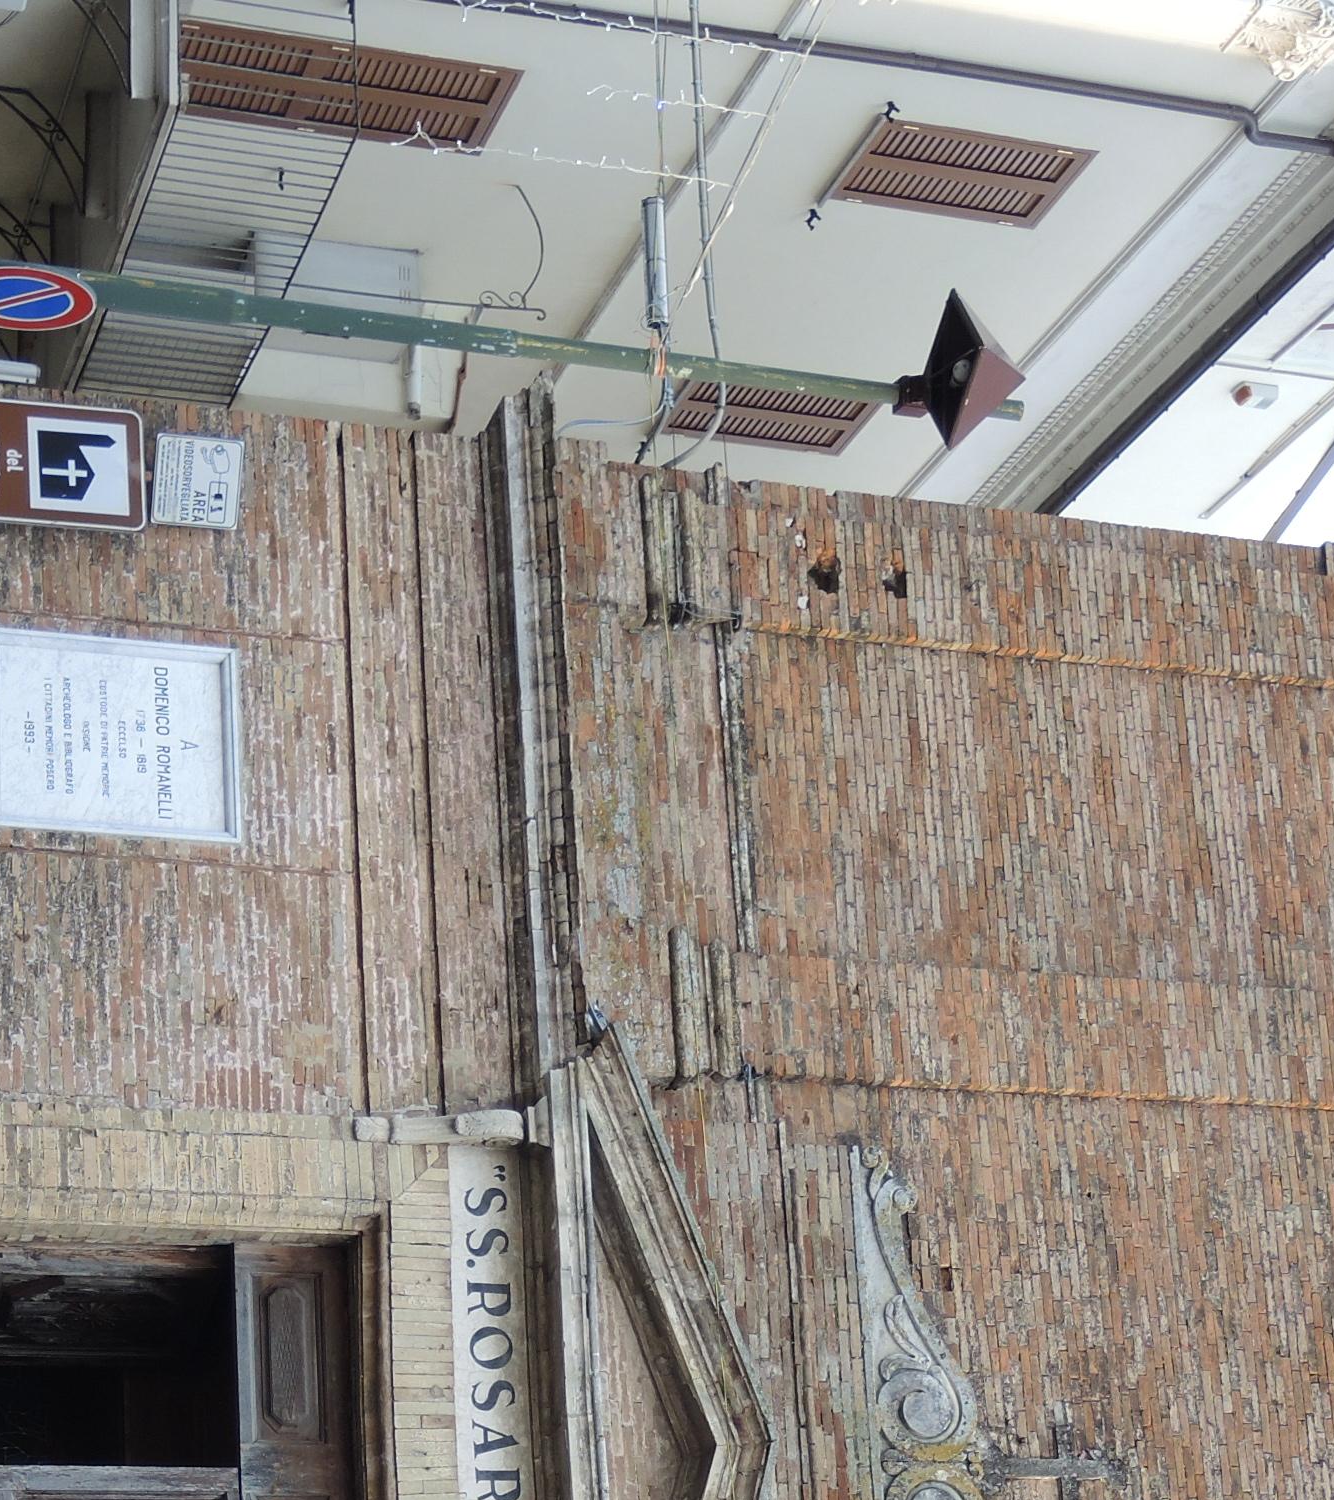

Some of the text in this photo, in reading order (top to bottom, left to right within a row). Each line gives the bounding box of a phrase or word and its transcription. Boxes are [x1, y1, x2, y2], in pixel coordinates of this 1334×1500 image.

[6, 449, 24, 472] del
[180, 441, 195, 521] VIDEOSORVEGLIATA
[192, 490, 206, 522] AREA
[44, 683, 53, 723] CITTADINI
[63, 677, 71, 729] ARCHEOLOGO
[99, 680, 107, 718] CUSTODE
[118, 720, 127, 759] ECCELSO
[154, 667, 172, 819] DOMENICO ROMANELLI
[180, 739, 200, 751] A
[46, 759, 55, 790] POSERO
[137, 753, 147, 774] 1819
